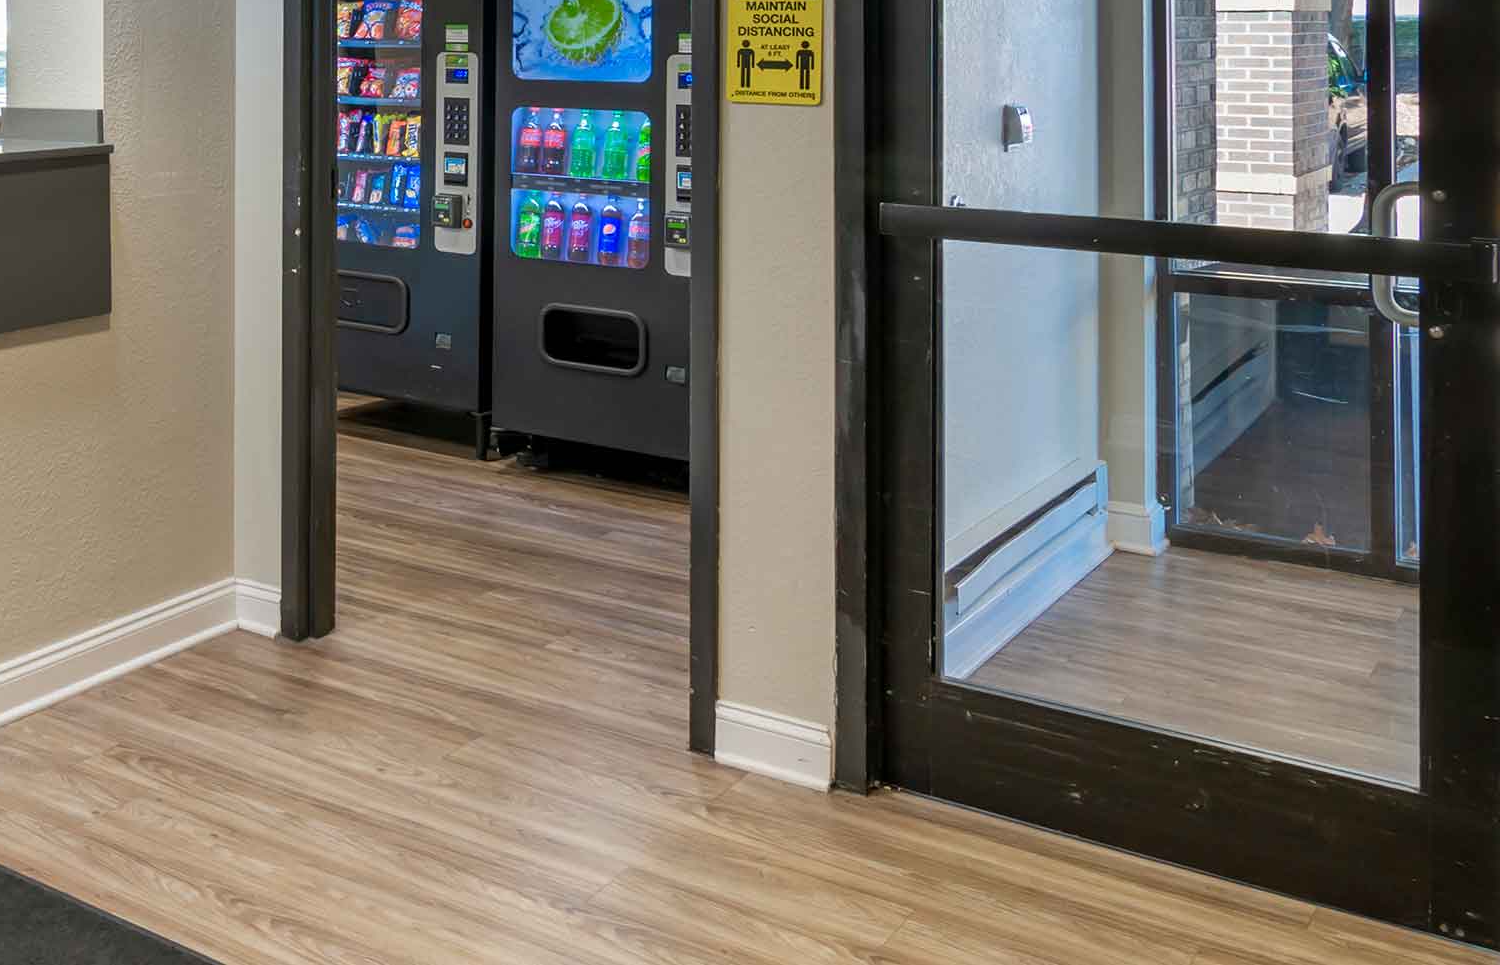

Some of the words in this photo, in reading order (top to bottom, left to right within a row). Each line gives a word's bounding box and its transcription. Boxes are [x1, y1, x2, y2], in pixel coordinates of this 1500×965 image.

[746, 1, 806, 11] MAINTAIN
[752, 14, 799, 24] SOCIAL
[738, 26, 814, 37] DISTANCING
